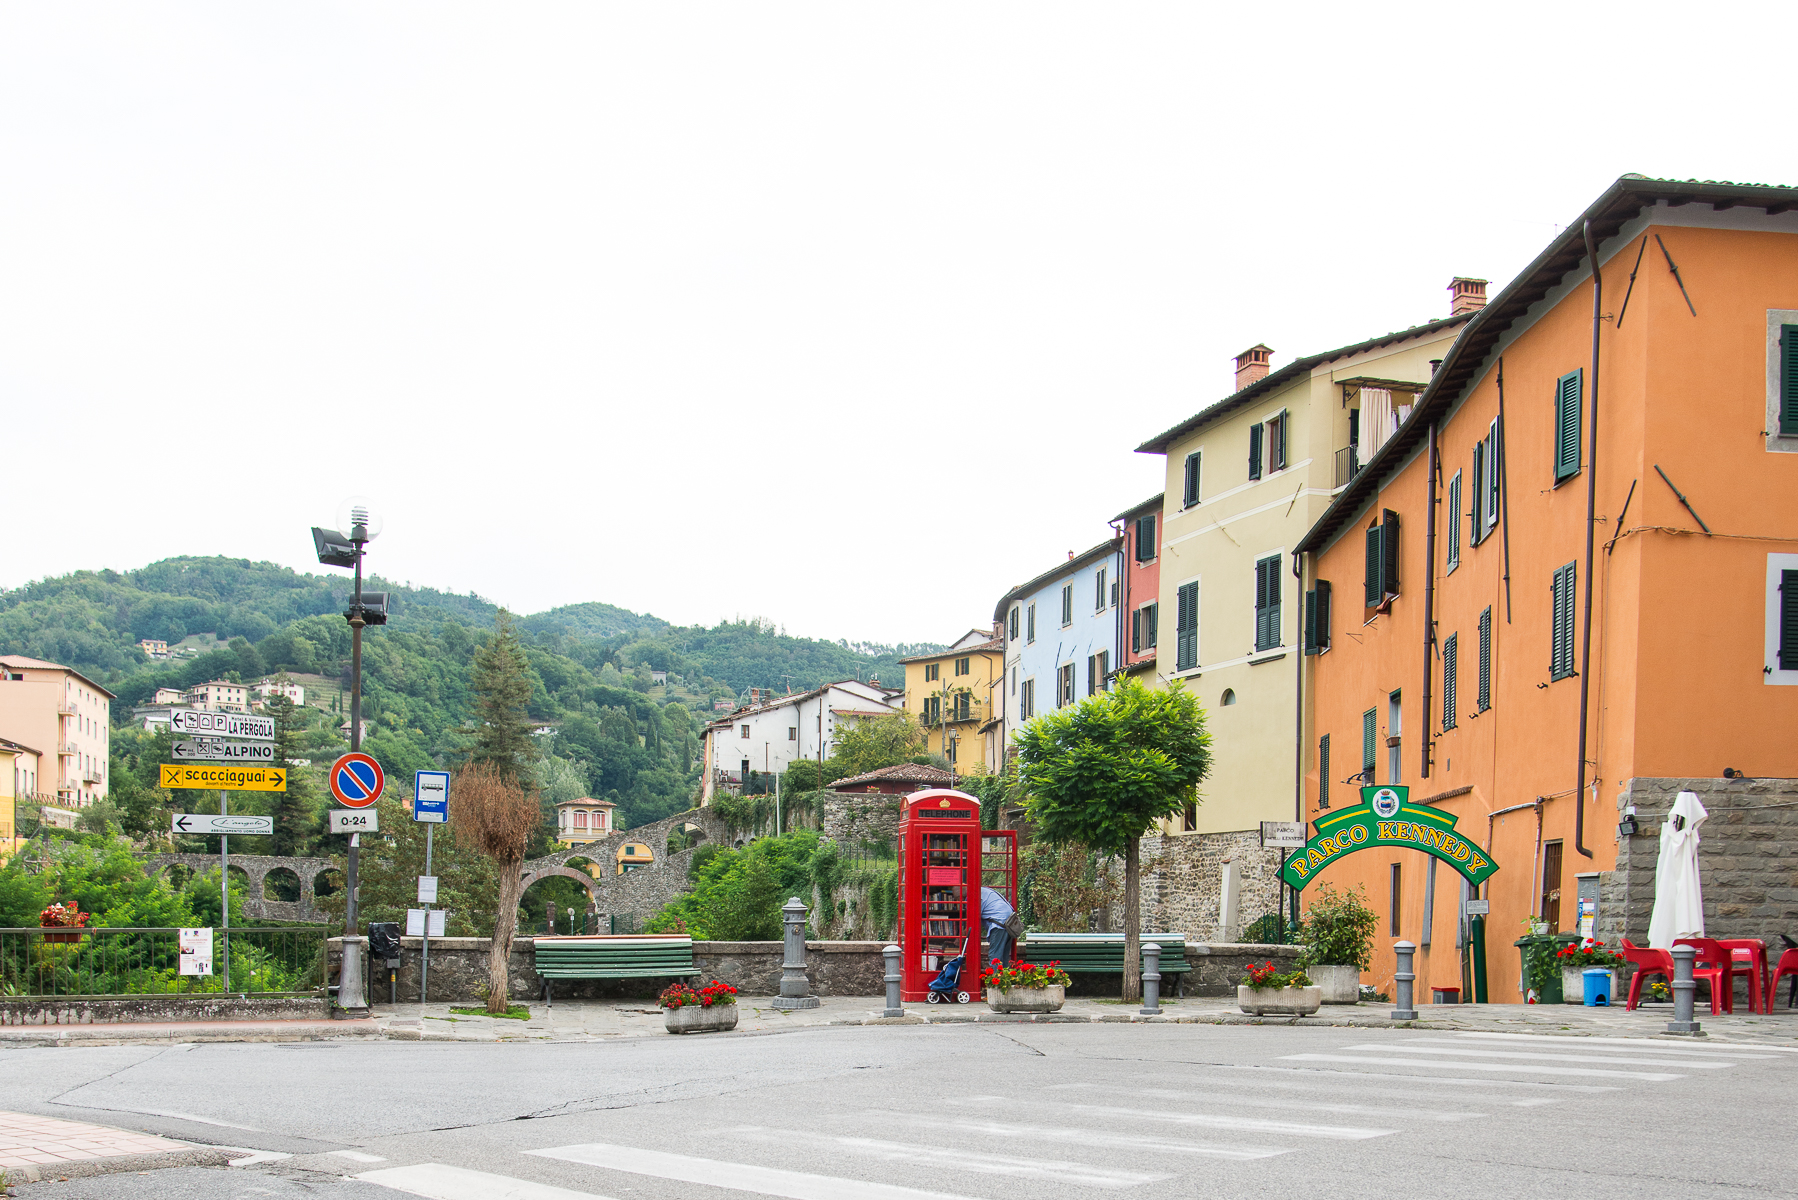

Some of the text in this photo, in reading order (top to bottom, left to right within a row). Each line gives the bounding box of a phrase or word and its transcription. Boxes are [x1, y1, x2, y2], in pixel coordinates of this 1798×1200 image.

[228, 721, 273, 738] LA PERGOLA
[224, 746, 271, 757] ALPINO
[185, 769, 265, 786] scacciaguai
[341, 816, 366, 826] 0-24
[919, 810, 971, 818] TELEPHONE
[1291, 820, 1488, 879] PARCO KENNEDY
